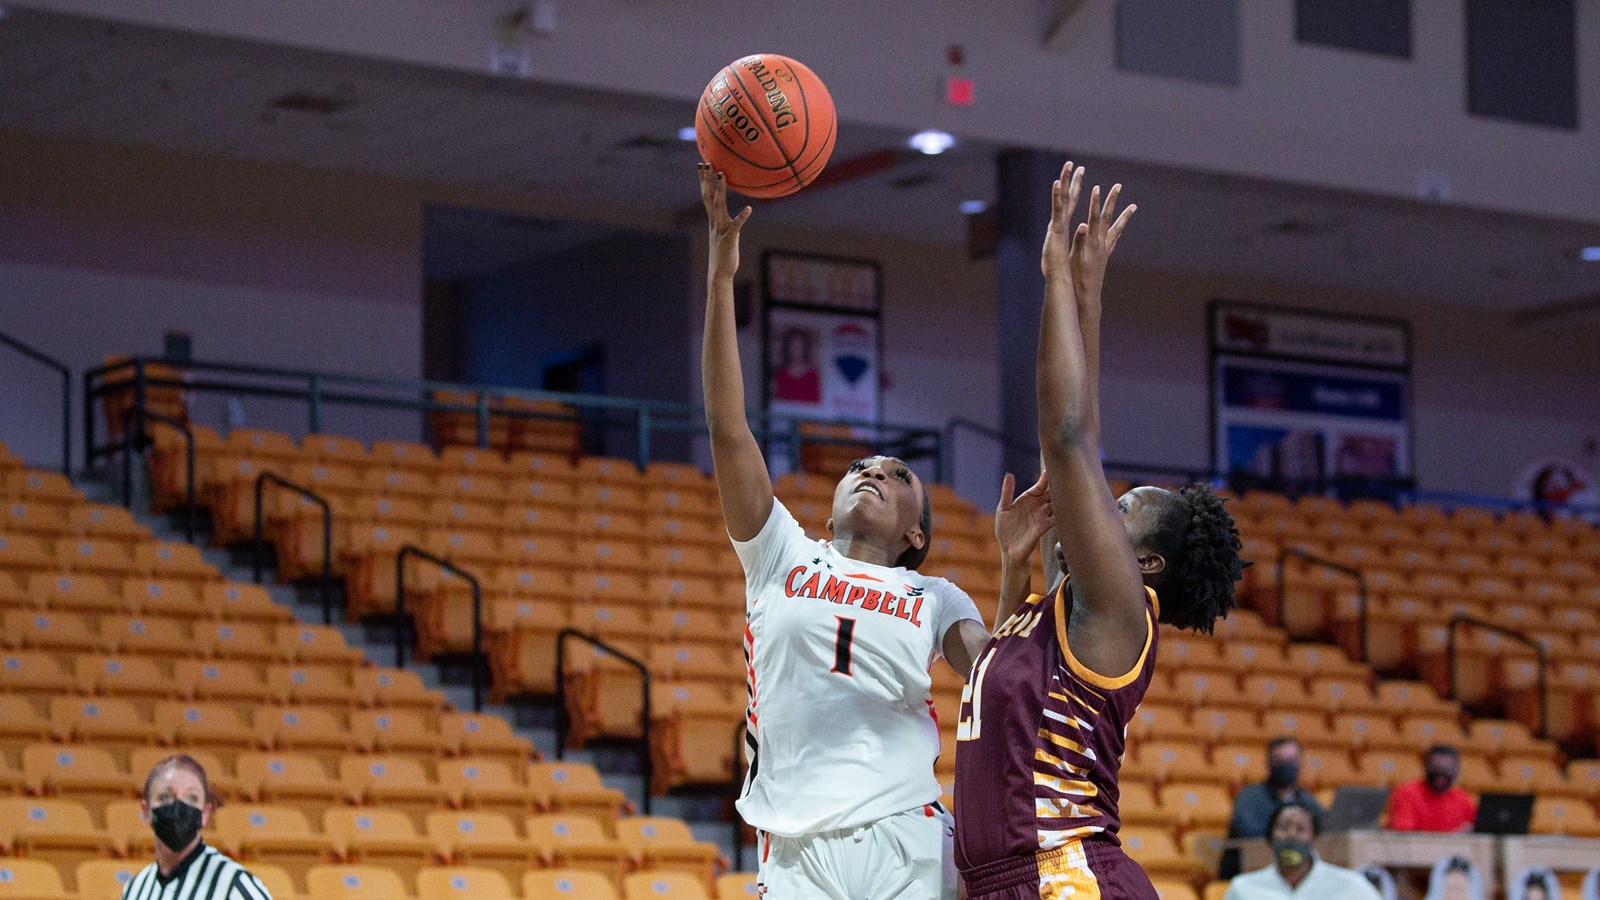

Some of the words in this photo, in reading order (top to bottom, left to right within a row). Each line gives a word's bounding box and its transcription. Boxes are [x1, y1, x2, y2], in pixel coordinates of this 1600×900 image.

[785, 565, 924, 628] CAMPBELL
[829, 615, 856, 677] 1
[957, 647, 997, 741] 21
